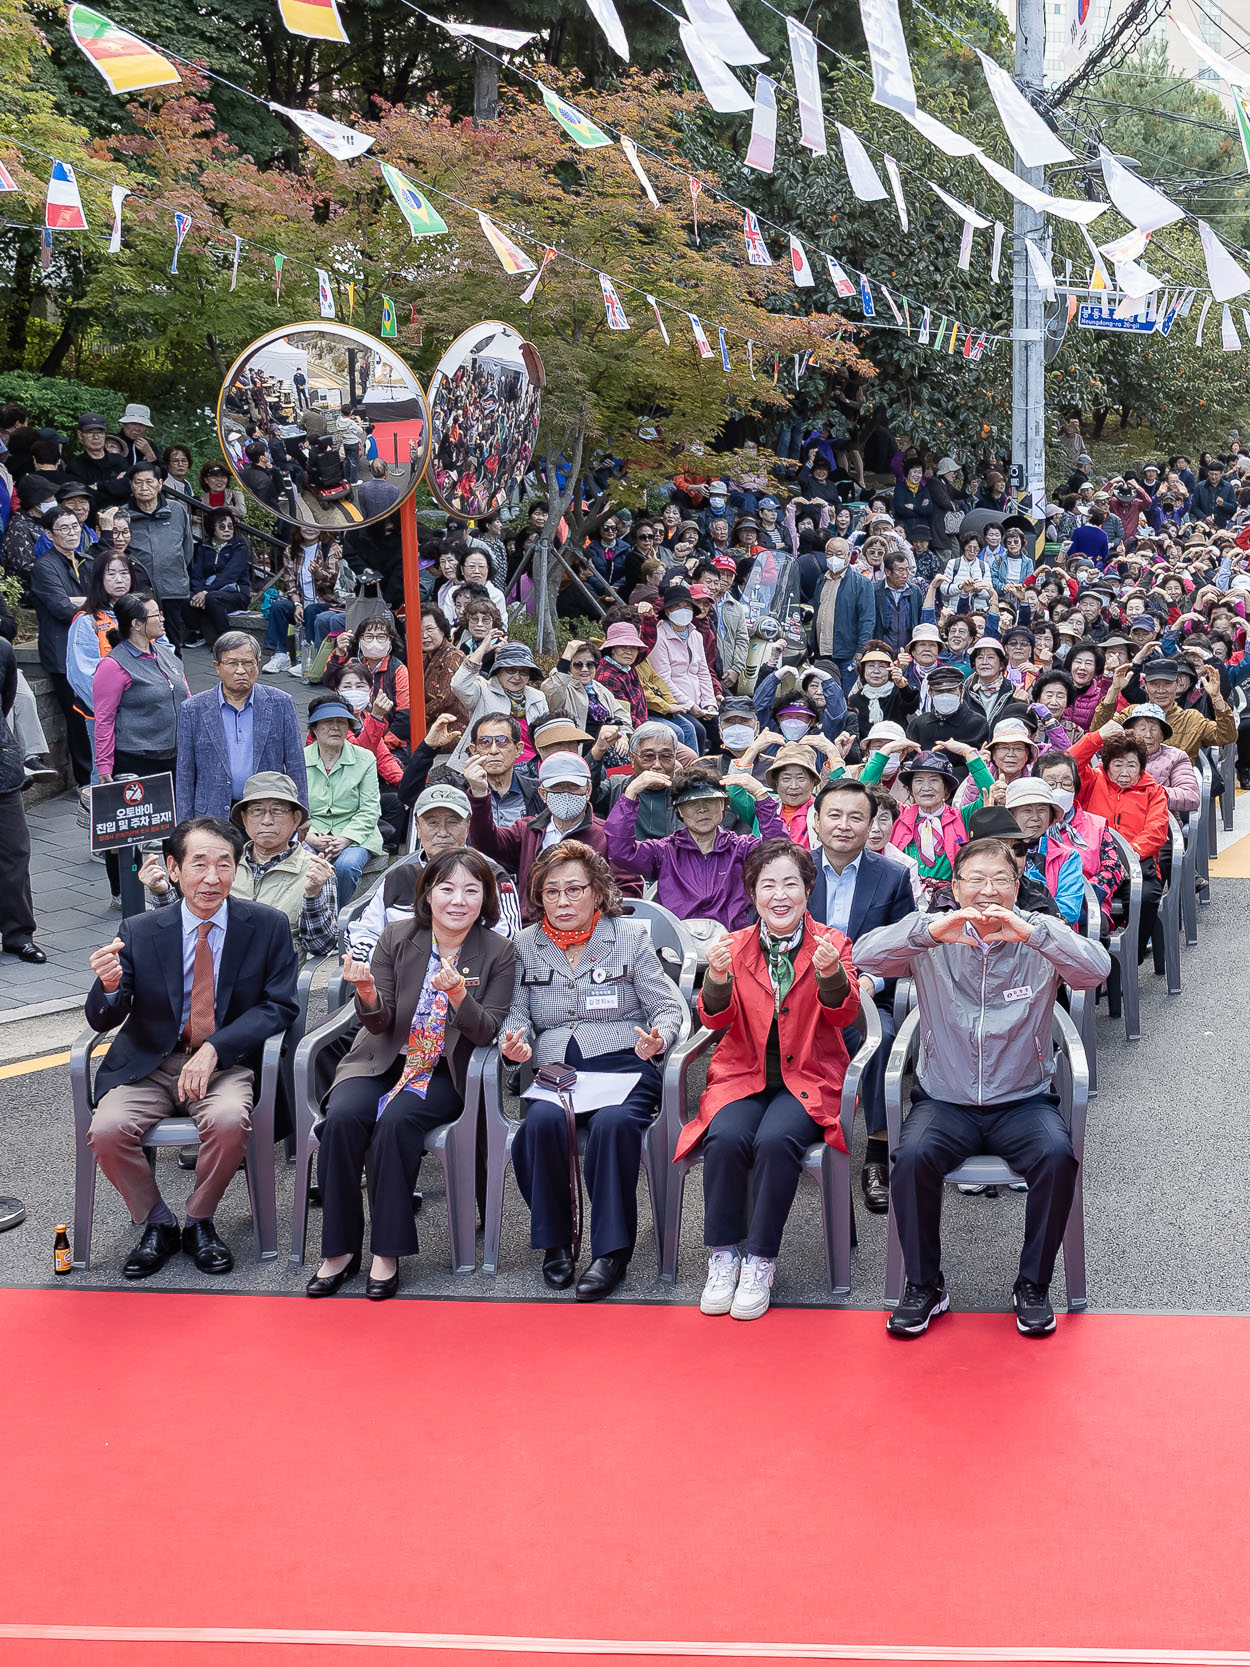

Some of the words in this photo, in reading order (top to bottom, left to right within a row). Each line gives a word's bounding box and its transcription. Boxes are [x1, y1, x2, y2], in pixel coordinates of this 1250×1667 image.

[1081, 319, 1122, 327] Neungdong-ro
[117, 804, 153, 819] 오토바이
[96, 821, 116, 834] 진입
[118, 819, 128, 831] 및
[130, 816, 149, 829] 주차
[151, 811, 172, 825] 금지!
